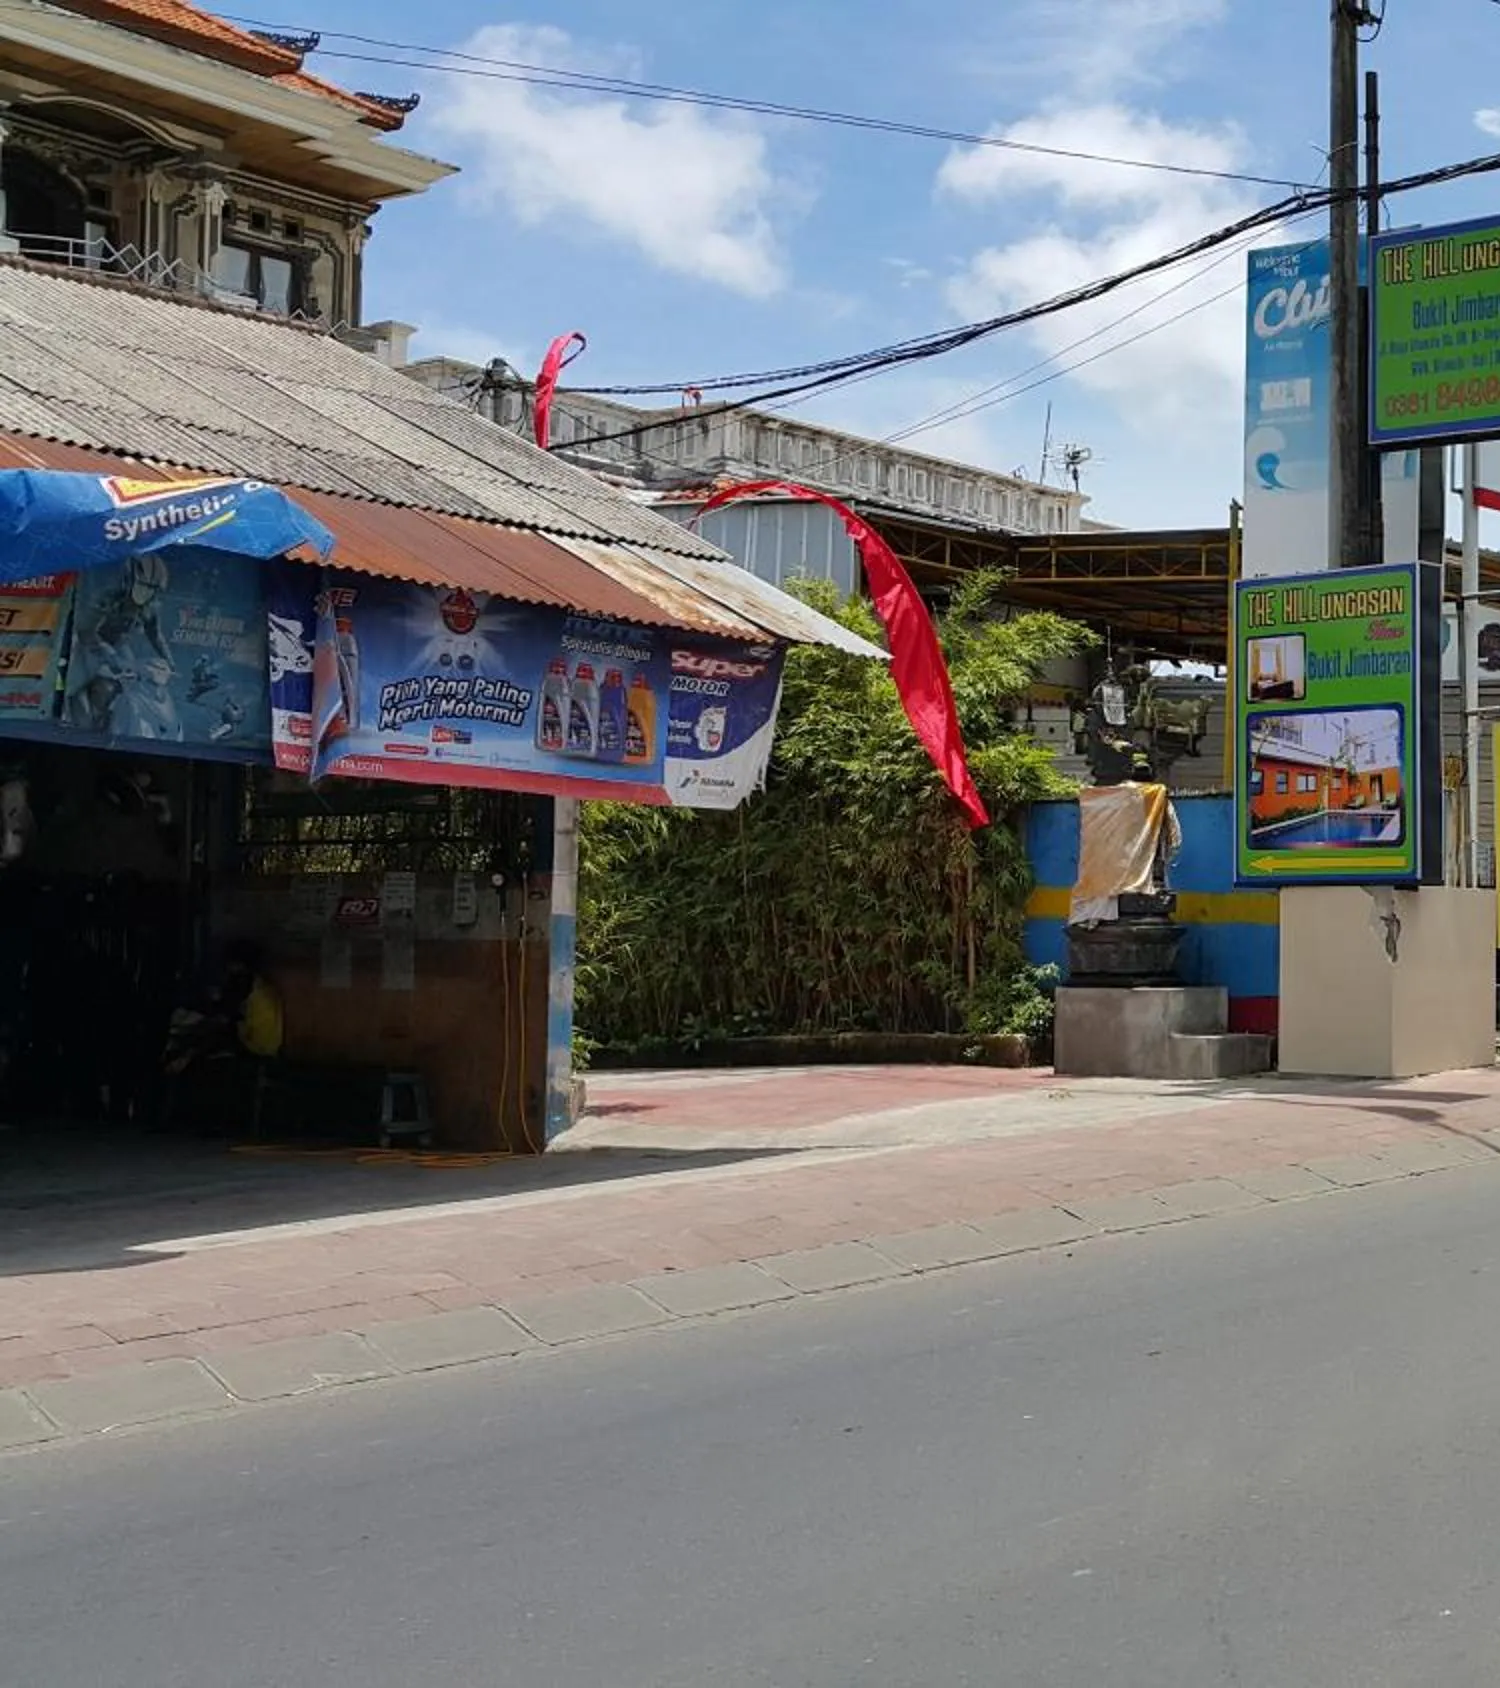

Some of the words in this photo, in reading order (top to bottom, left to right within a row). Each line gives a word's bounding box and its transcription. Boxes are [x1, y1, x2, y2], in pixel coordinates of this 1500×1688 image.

[1383, 246, 1413, 286] THE
[1422, 238, 1459, 280] HILL
[1413, 296, 1448, 330] Bukit
[1247, 591, 1276, 629] THE
[1283, 585, 1318, 625] HILL
[1320, 585, 1406, 620] UNGASAN
[1307, 651, 1342, 680] Bukit
[1344, 646, 1411, 677] Jimbaran
[425, 677, 469, 699] Yang
[473, 677, 532, 709] Paling
[671, 675, 732, 697] MOTOR
[438, 699, 525, 726] Motormu
